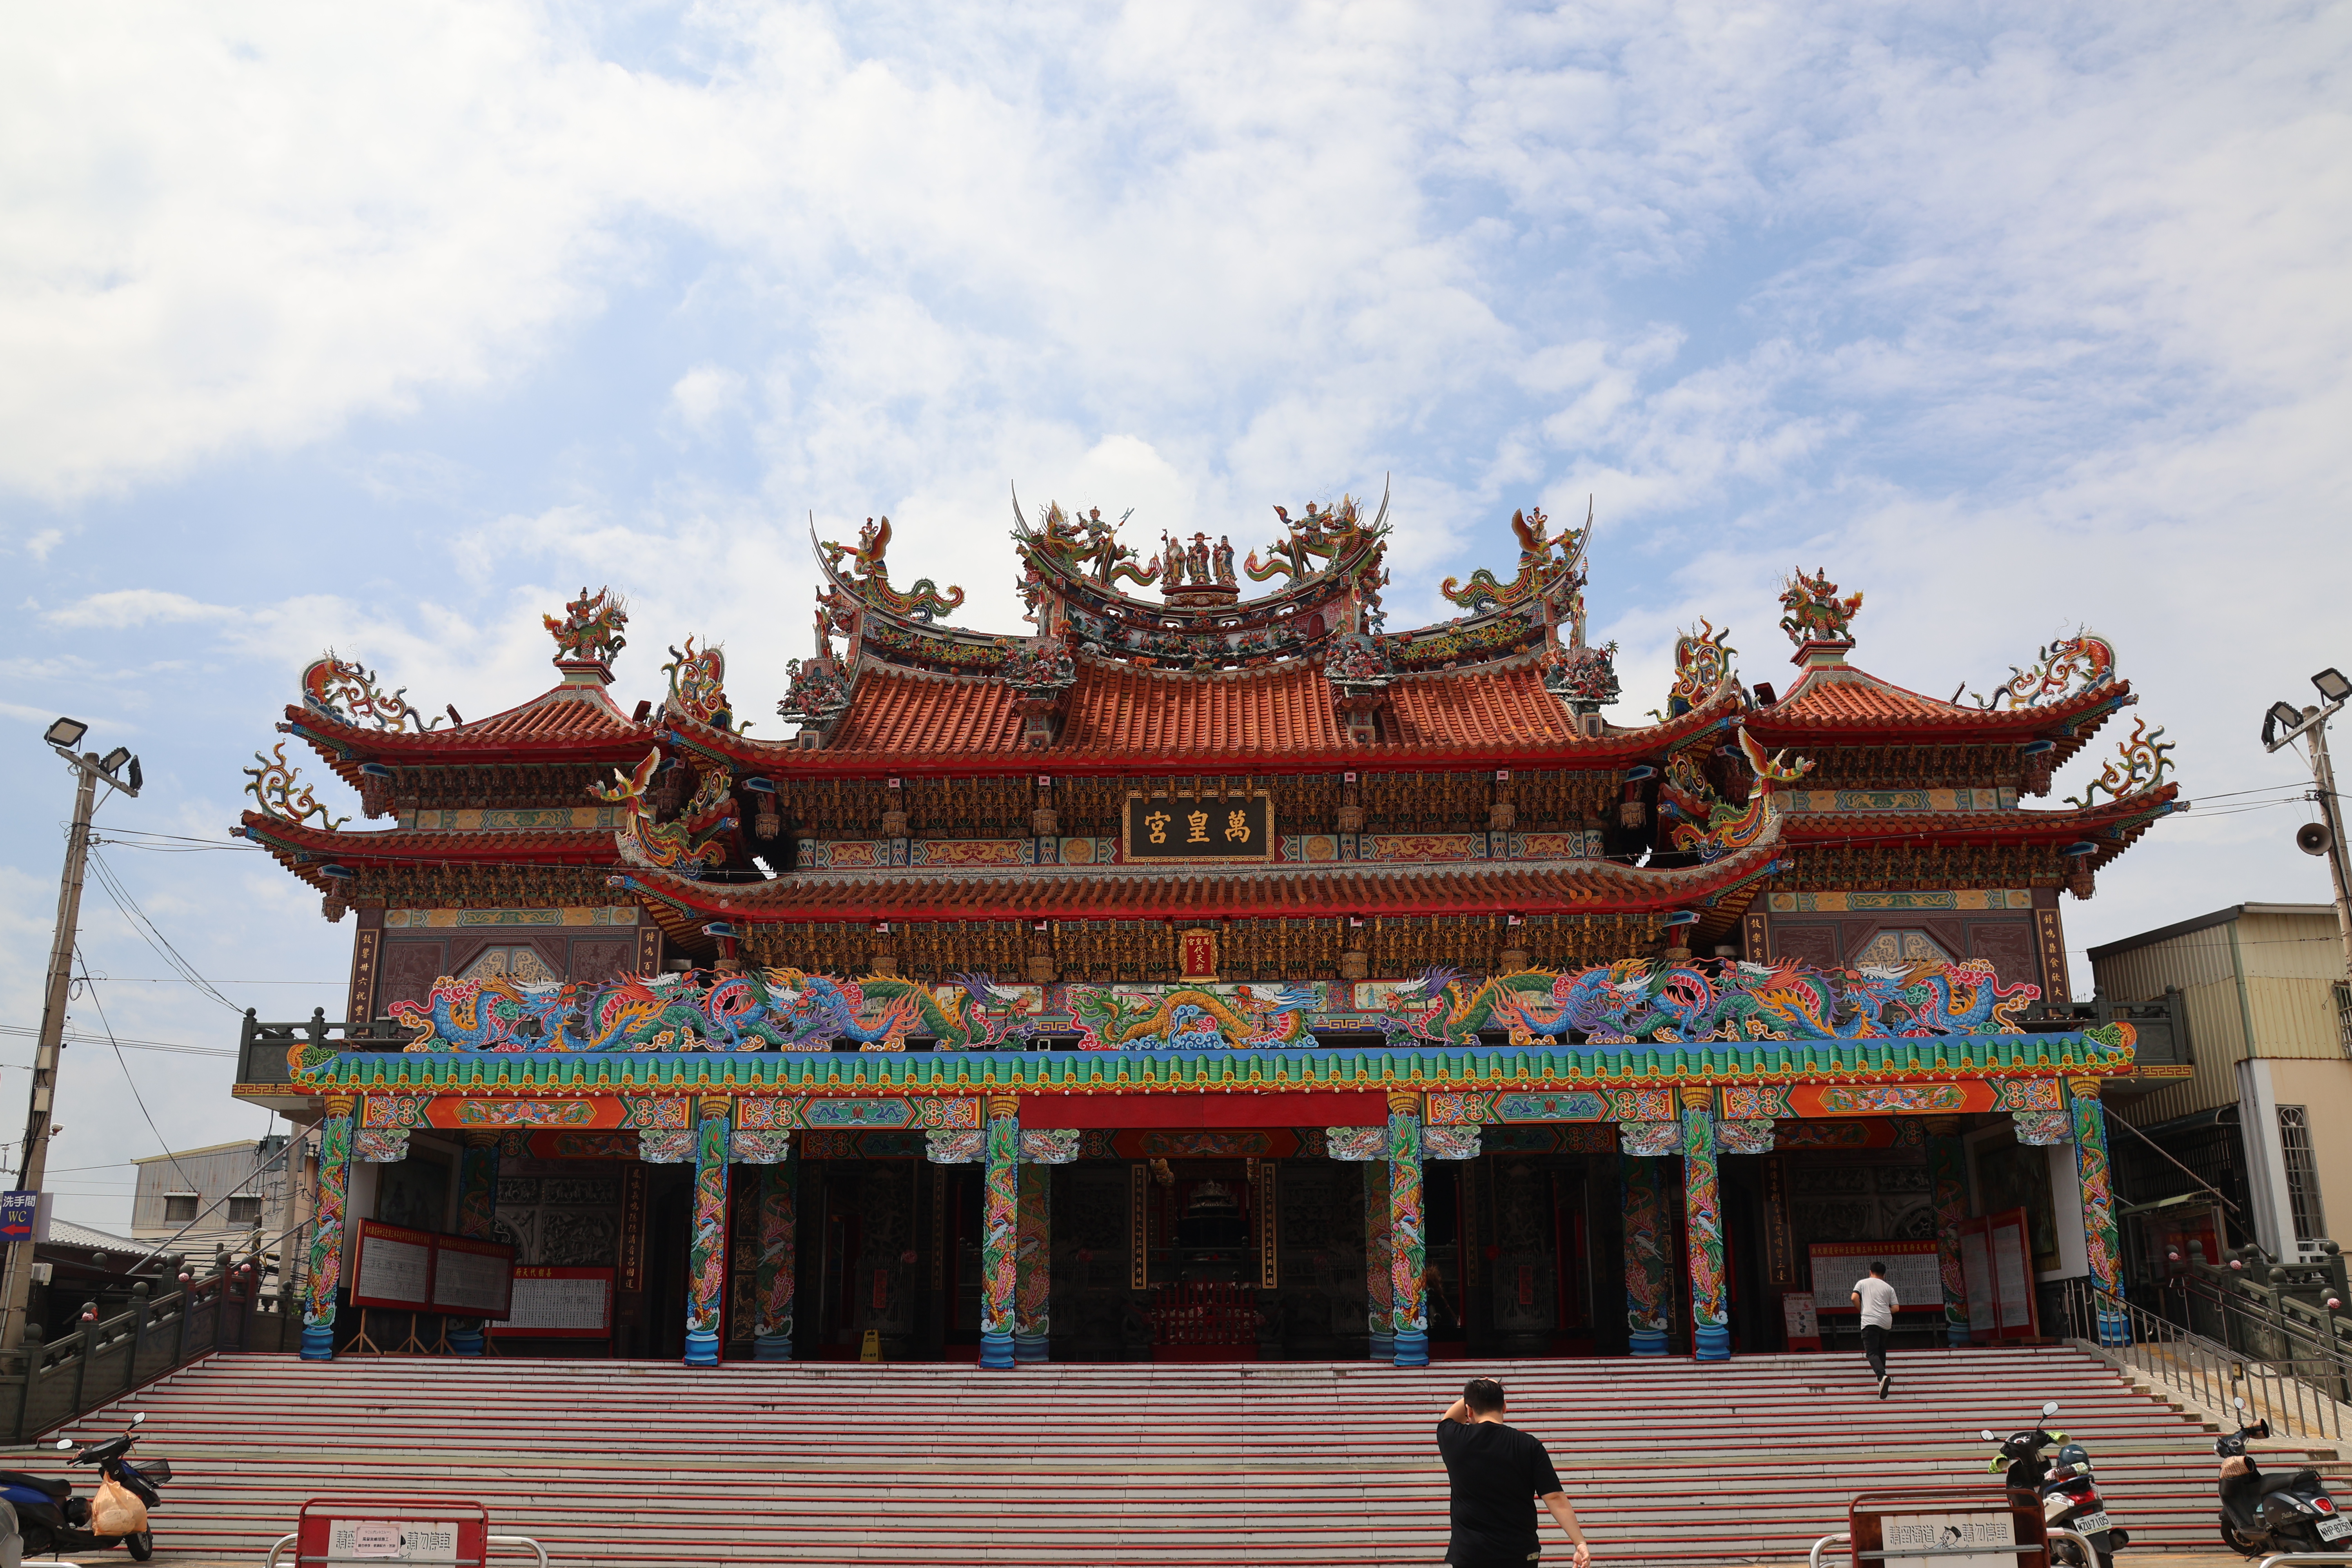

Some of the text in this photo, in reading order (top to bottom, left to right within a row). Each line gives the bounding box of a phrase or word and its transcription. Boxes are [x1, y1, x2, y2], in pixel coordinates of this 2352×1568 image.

[1194, 946, 1205, 972] 代天府
[2043, 914, 2064, 1003] 鐘鳴鼎食欣大
[2, 1195, 36, 1207] 洗手間
[8, 1210, 27, 1223] WC
[1889, 1524, 1935, 1545] 請留通道
[1962, 1522, 2008, 1543] 請勿停車
[2076, 1515, 2109, 1533] MZU-7105
[2319, 1521, 2352, 1537] NHP-8750
[407, 1531, 451, 1552] 請勿停車
